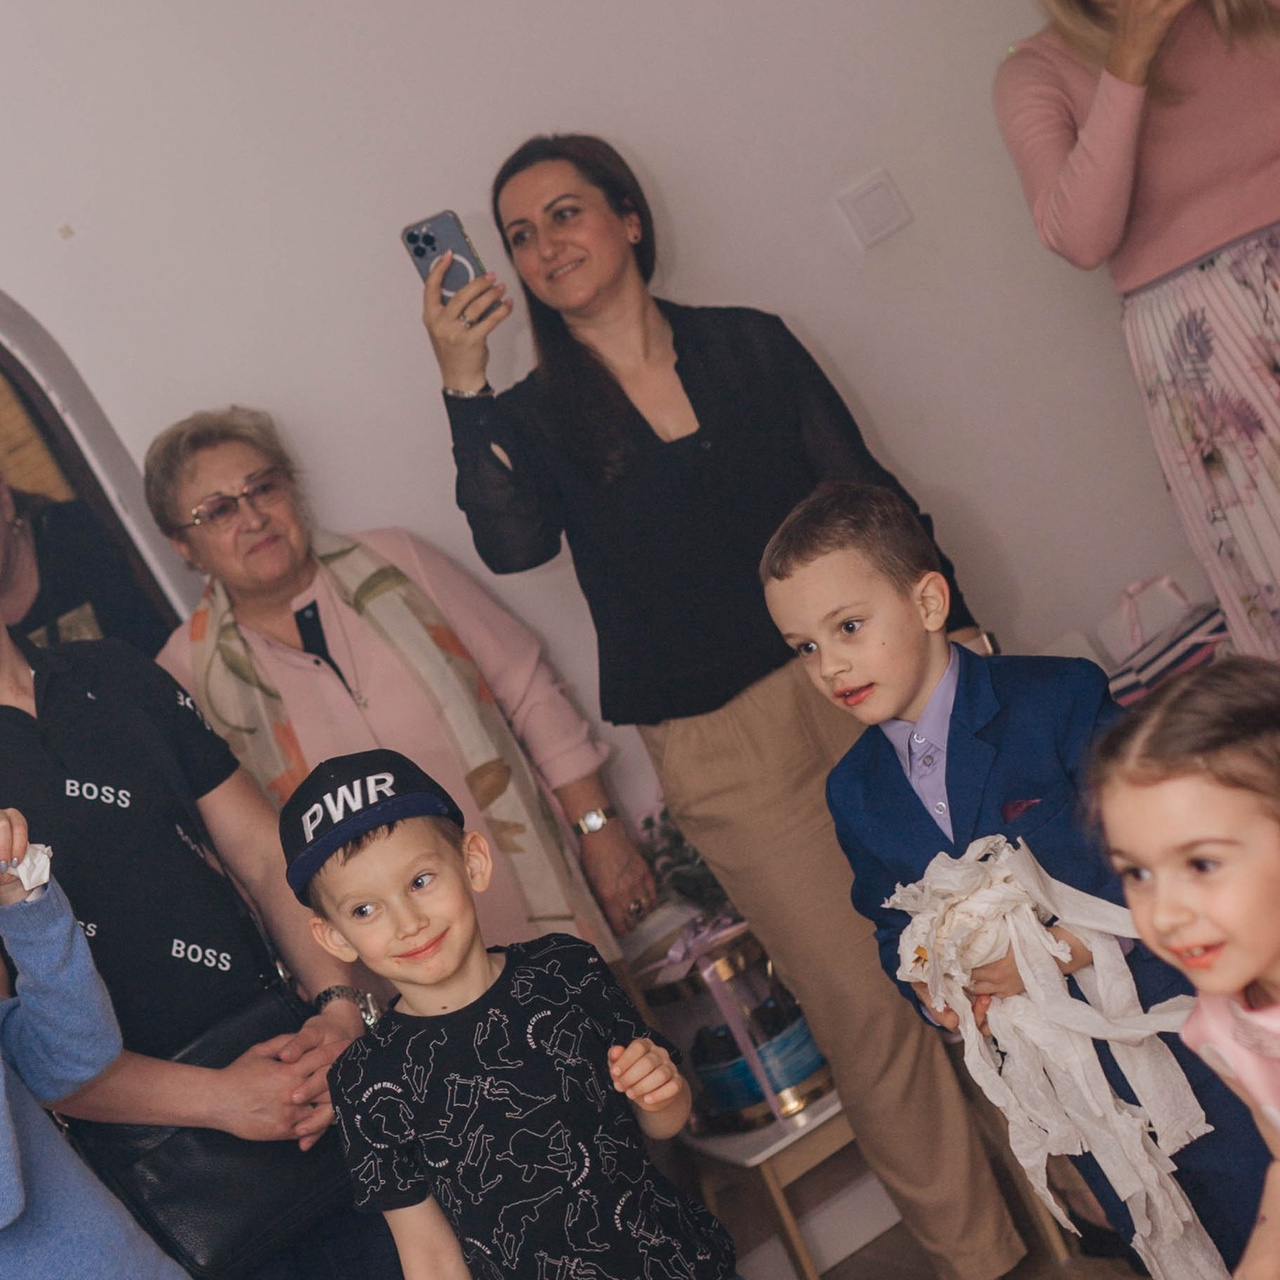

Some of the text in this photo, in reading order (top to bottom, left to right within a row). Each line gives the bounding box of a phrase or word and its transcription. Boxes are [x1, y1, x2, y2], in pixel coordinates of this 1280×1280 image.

[65, 779, 131, 808] BOSS
[301, 772, 396, 844] PWR
[171, 938, 232, 971] BOSS
